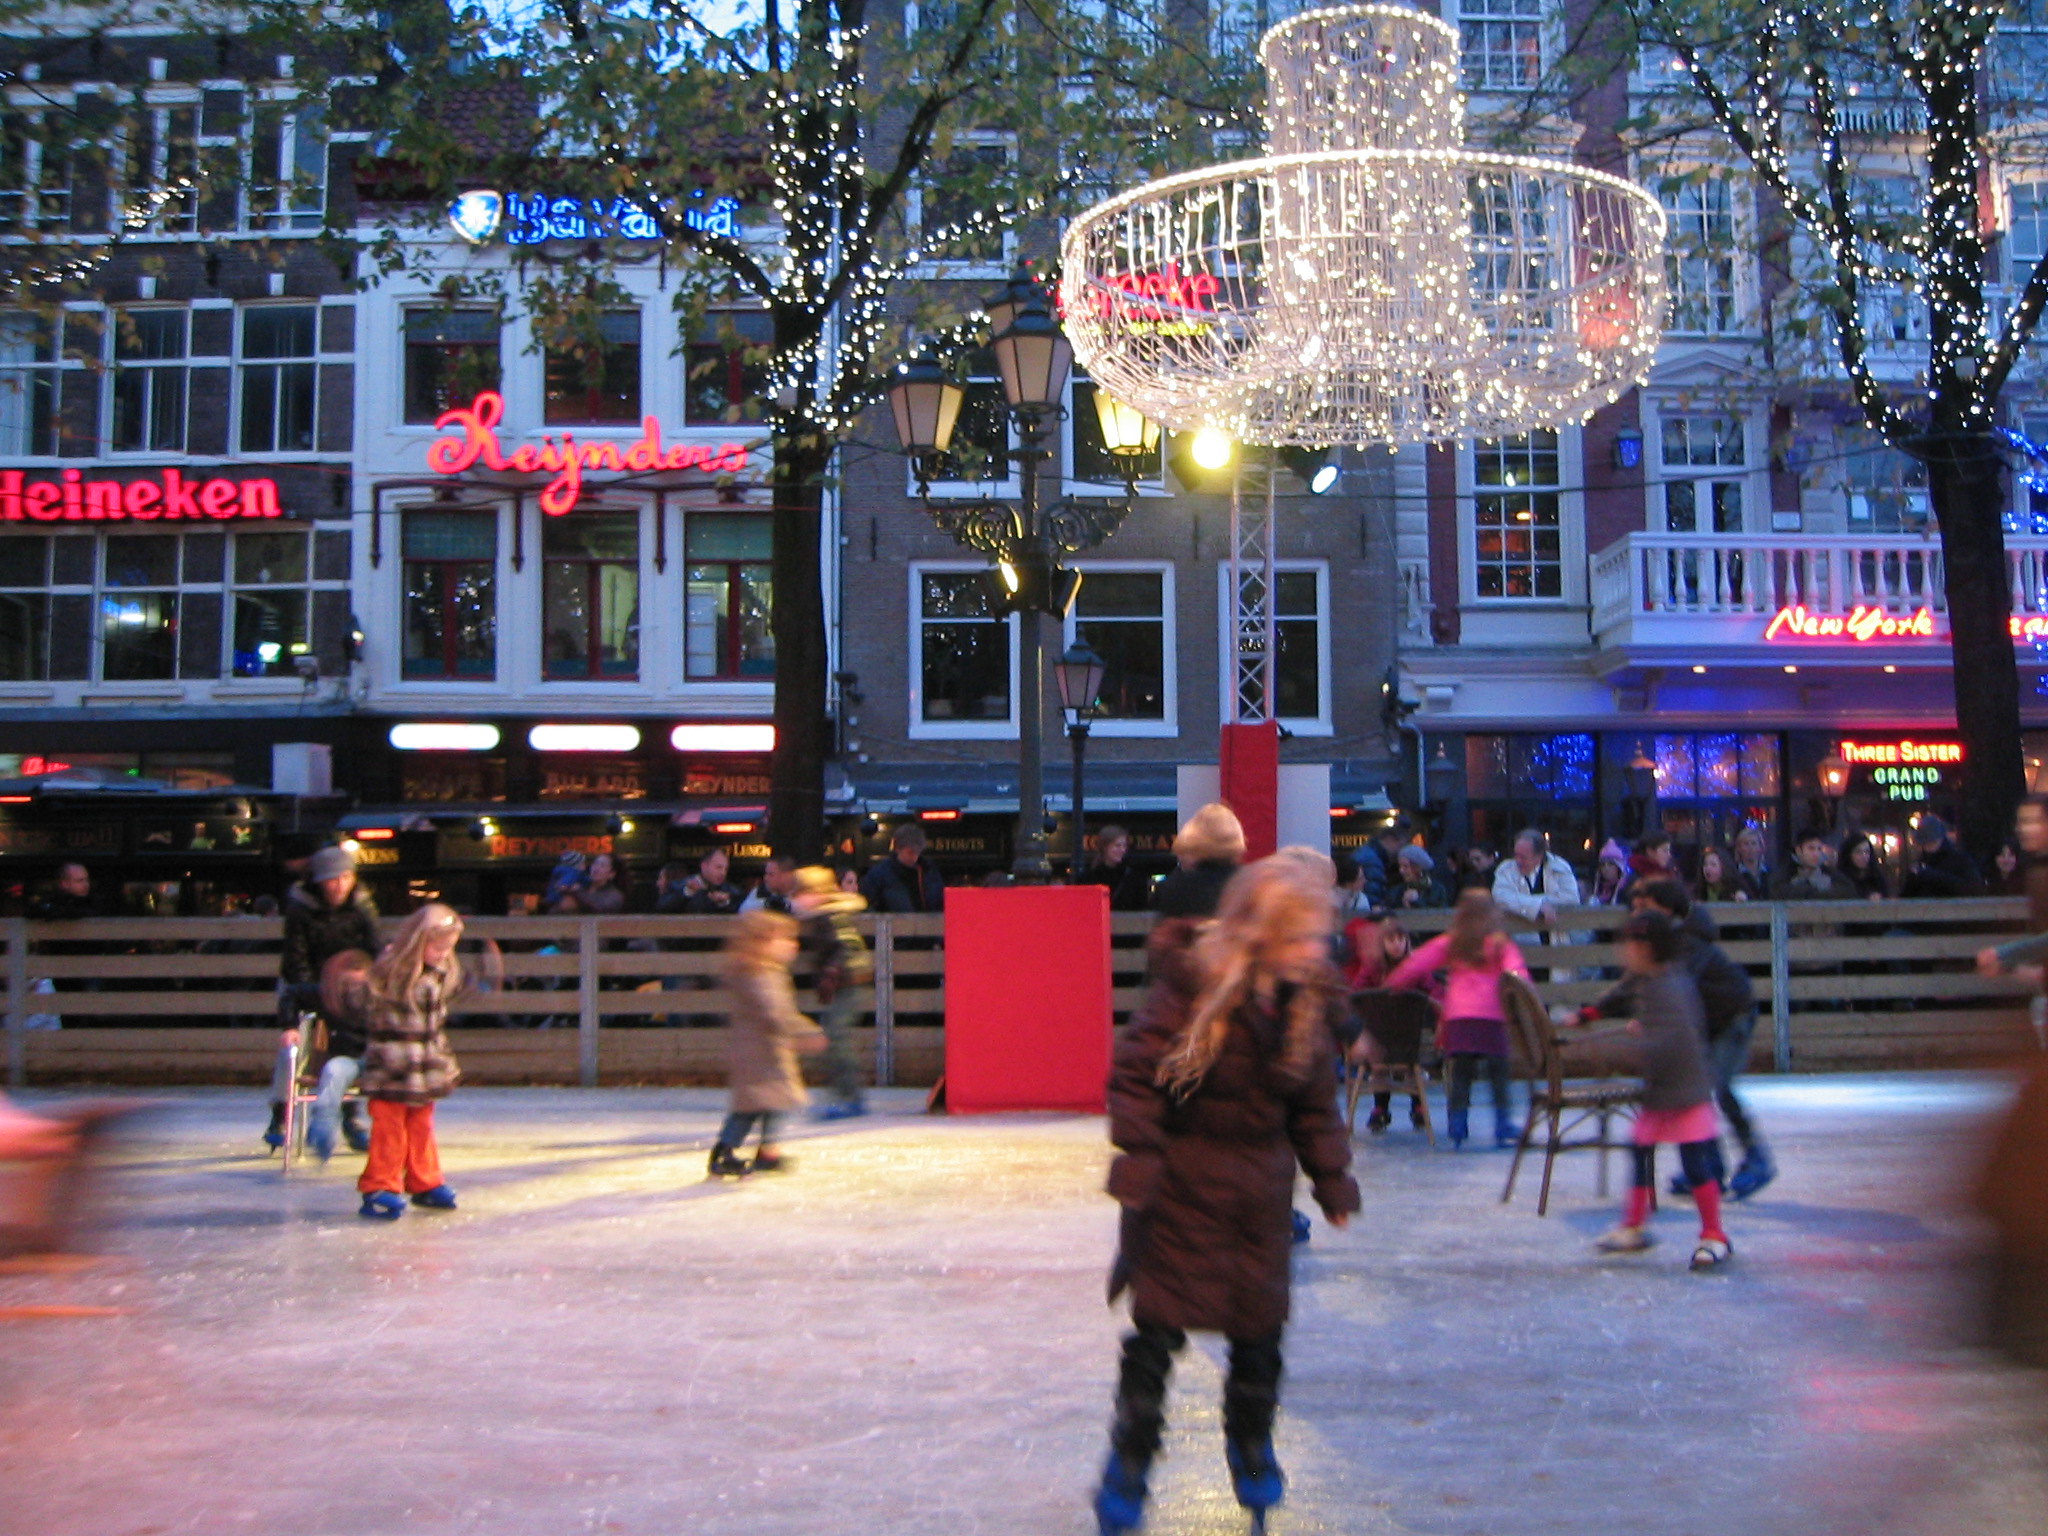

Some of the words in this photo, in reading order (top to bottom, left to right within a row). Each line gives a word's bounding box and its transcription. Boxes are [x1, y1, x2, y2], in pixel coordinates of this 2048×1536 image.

[506, 190, 741, 245] Bavaia
[427, 391, 748, 516] Reijnders
[1765, 605, 1843, 641] New
[1847, 605, 1933, 642] York
[1874, 766, 1939, 785] GRAND
[1889, 784, 1926, 801] PUB
